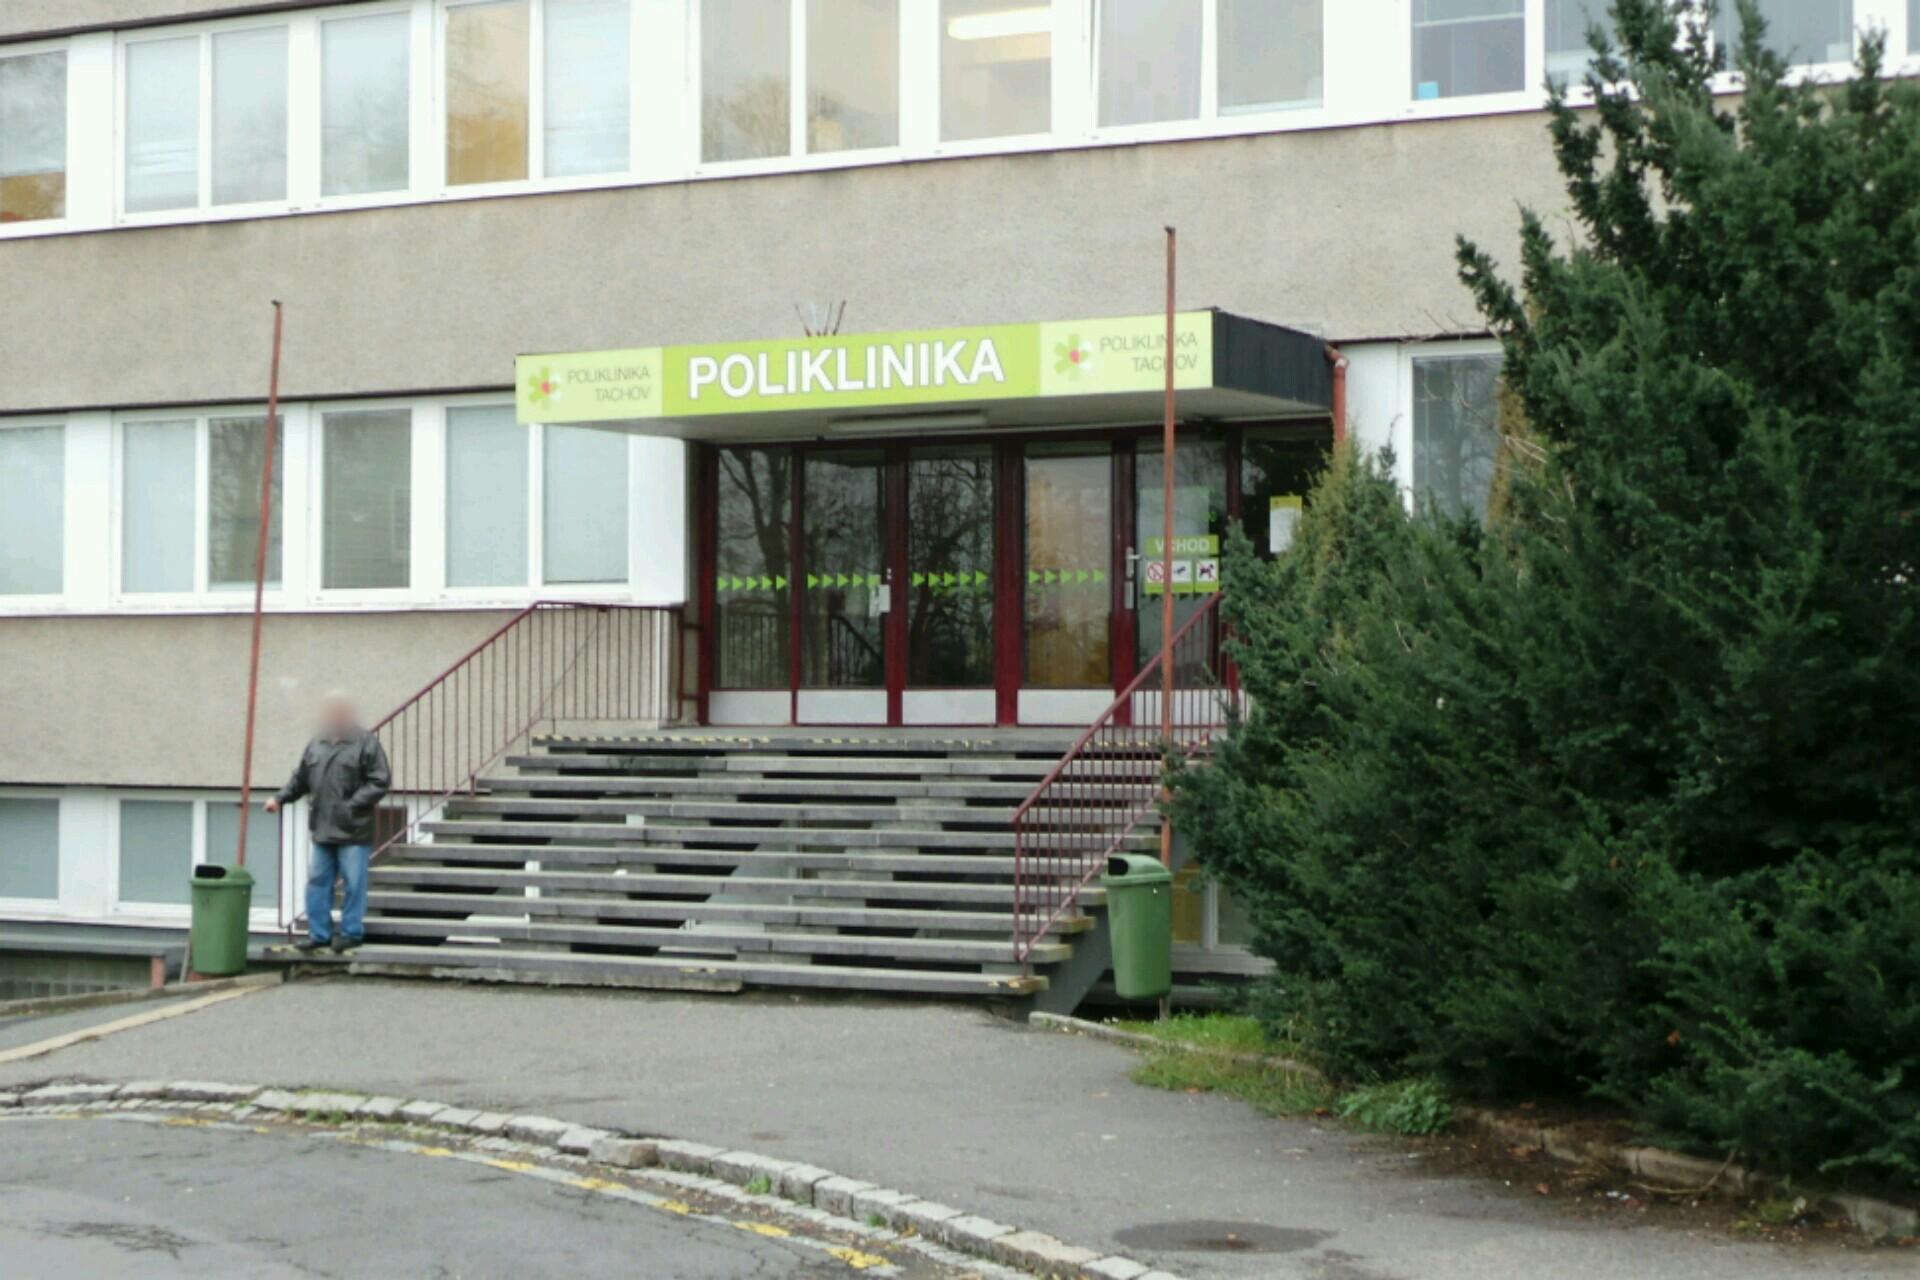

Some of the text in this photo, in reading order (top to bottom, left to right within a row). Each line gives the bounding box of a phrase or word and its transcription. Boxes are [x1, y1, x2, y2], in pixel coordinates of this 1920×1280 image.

[1099, 331, 1198, 352] POLIKLINKA
[568, 365, 650, 384] POLIKLINIKA
[688, 338, 1006, 401] POLIKLINIKA
[595, 385, 650, 401] TACHOV
